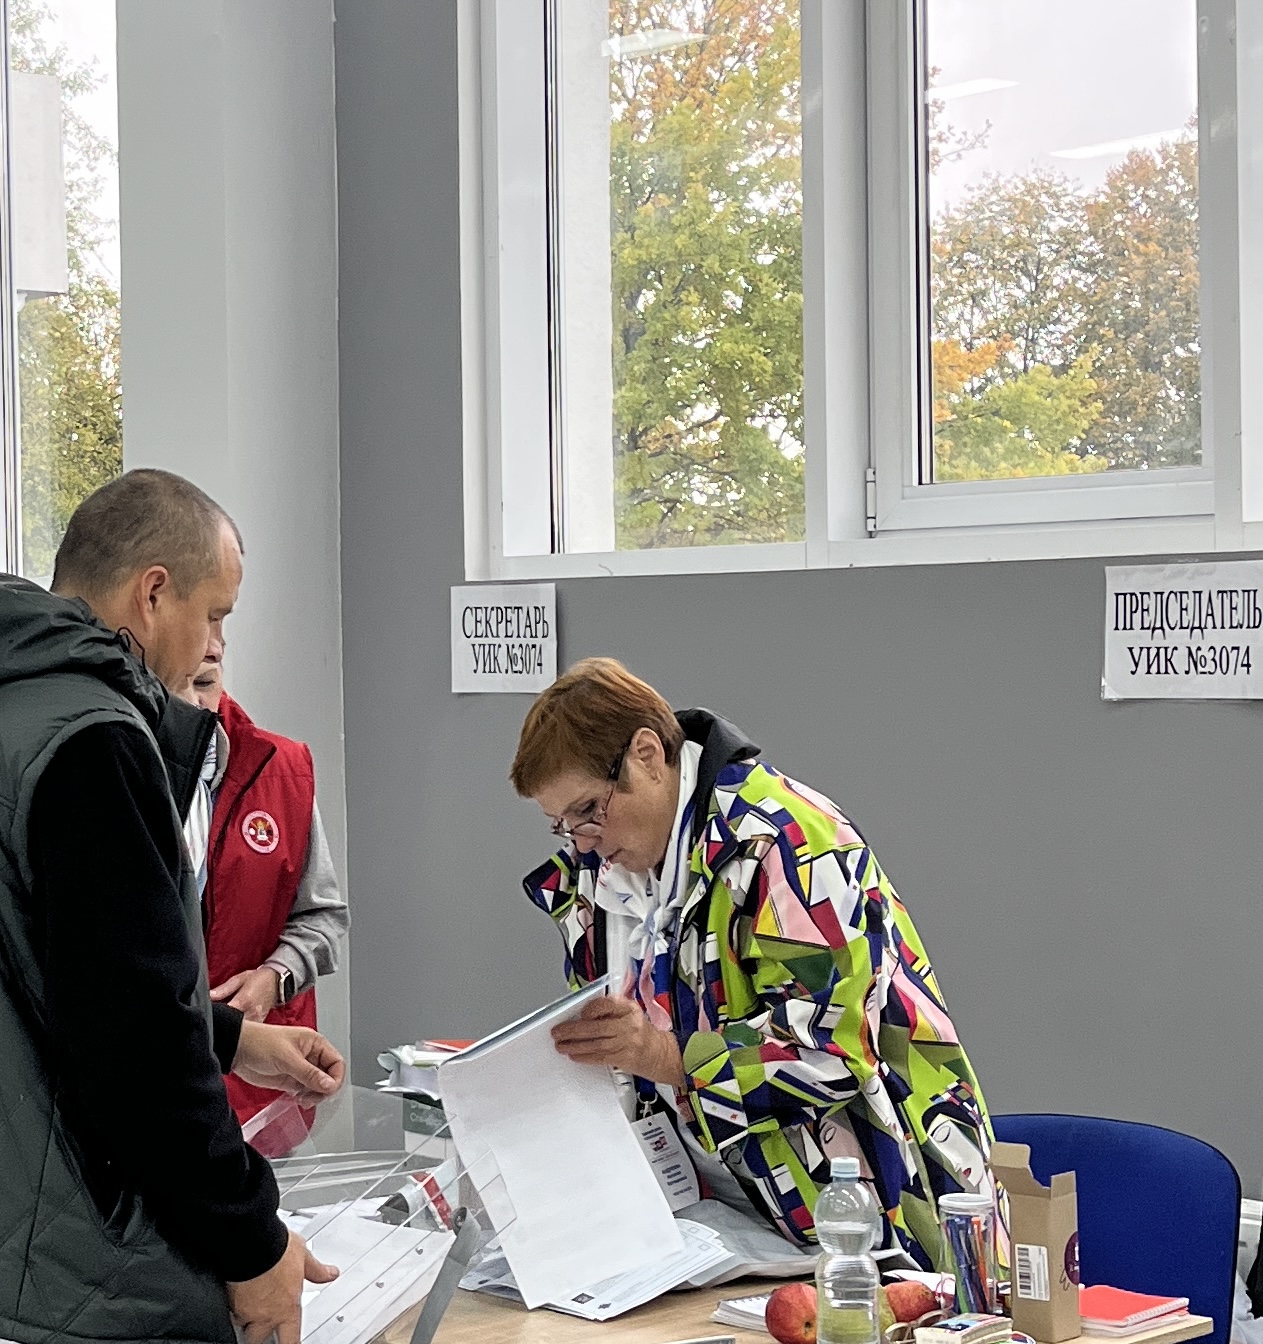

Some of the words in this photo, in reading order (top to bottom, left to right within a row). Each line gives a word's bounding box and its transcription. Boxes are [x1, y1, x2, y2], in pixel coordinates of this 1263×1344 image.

[462, 605, 549, 639] СЕКРЕТАРЬ
[1113, 589, 1262, 640] ПРЕДСЕДАТЕЛЬ
[471, 644, 502, 673] УИК
[505, 643, 543, 675] №3074
[1127, 646, 1179, 675] УИК
[1184, 645, 1252, 675] №3074
